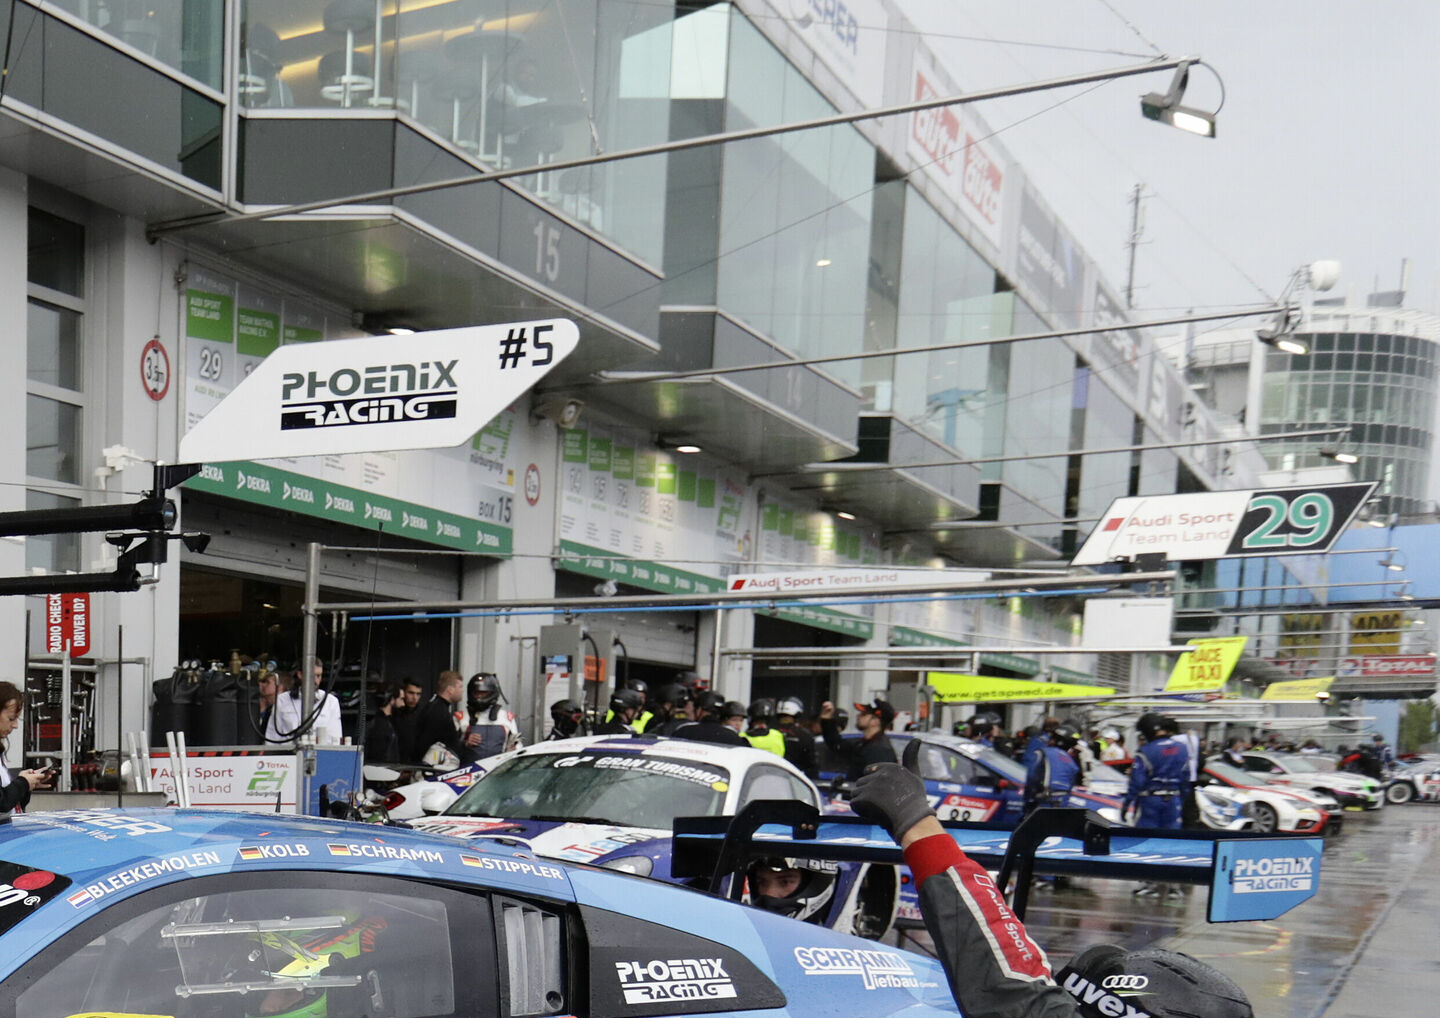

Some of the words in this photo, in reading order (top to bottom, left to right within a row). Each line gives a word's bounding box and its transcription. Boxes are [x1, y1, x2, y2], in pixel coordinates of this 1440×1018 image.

[534, 220, 560, 282] 15
[500, 324, 555, 370] #5
[199, 346, 222, 382] 29
[282, 359, 458, 401] PHOENIX
[304, 398, 430, 427] RACING
[247, 474, 271, 494] DEKRA
[291, 484, 314, 504] DEKRA
[333, 493, 355, 514] DEKRA
[372, 503, 392, 522] DEKRA
[479, 501, 496, 519] BOX
[498, 496, 512, 523] 15
[1127, 515, 1172, 529] Audi
[1177, 510, 1235, 530] Sport
[1242, 493, 1334, 549] 29
[1126, 531, 1172, 545] Team
[1179, 528, 1231, 544] Land
[748, 576, 780, 588] Audi
[784, 574, 824, 591] Sport
[827, 574, 861, 587] Team
[864, 571, 898, 585] Land
[49, 593, 62, 624] CHECK
[72, 597, 86, 612] ID?
[49, 625, 62, 653] RADIO
[73, 613, 86, 647] DRIVER
[1188, 664, 1223, 681] TAXI
[1363, 658, 1435, 673] TOTAL
[194, 766, 234, 781] Sport
[266, 761, 290, 769] TOTAL
[595, 756, 646, 769] GRAN
[646, 759, 721, 783] TURISMO
[198, 783, 232, 794] Land
[260, 843, 310, 860] KOLB
[348, 843, 445, 865] SCHRAMM
[88, 850, 220, 902] BLEEKEMOLEN
[481, 856, 564, 881] STIPPLER
[1233, 855, 1314, 878] PHOENIX
[1244, 876, 1300, 891] RACING
[1004, 921, 1033, 961] Sport
[794, 947, 911, 971] SCHRAMM
[615, 957, 731, 984] PHOENIX
[642, 983, 718, 1000] RACING
